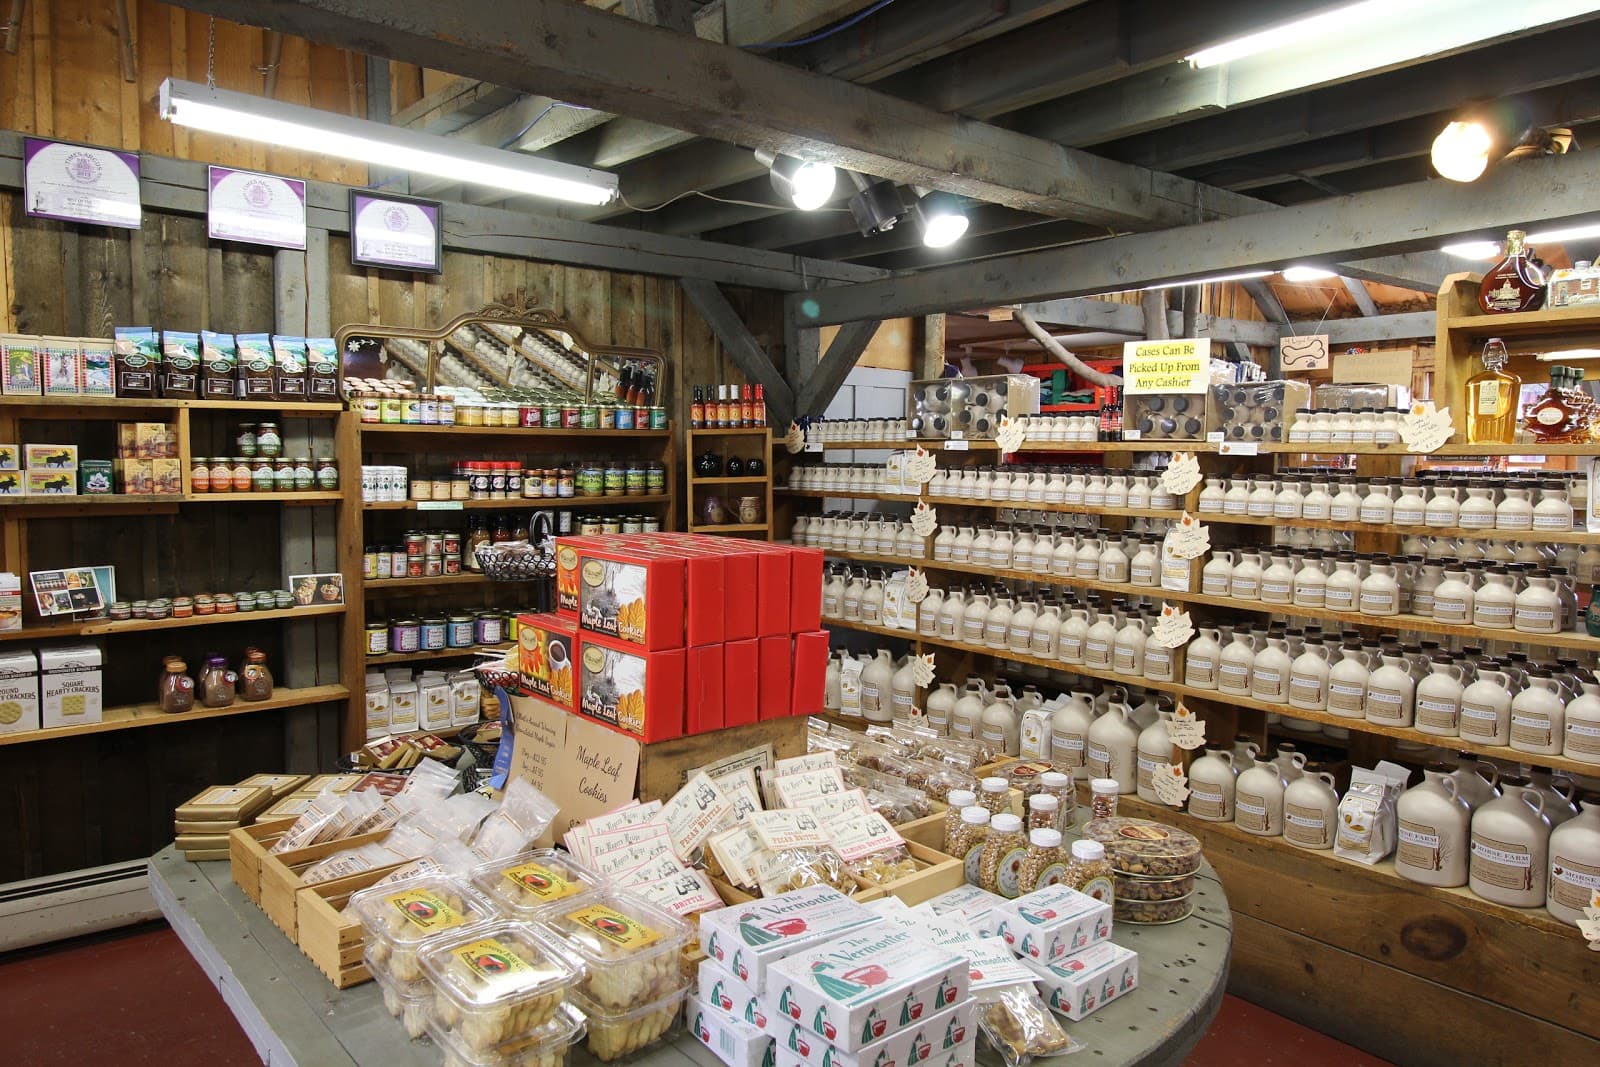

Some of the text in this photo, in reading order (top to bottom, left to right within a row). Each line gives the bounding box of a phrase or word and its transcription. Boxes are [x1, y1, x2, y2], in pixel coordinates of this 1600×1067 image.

[1136, 345, 1195, 357] Cases Can Be
[1129, 362, 1200, 374] Picked Up From
[1136, 377, 1192, 389] Any Cashier
[560, 594, 578, 608] Maple
[581, 612, 644, 637] Maple Leaf Cookies
[62, 680, 84, 688] SQUARE
[521, 672, 570, 699] Maple Leaf Cookies
[46, 688, 70, 698] HEARTY
[582, 698, 641, 728] Maple Leaf Cookies
[576, 745, 622, 782] Maple Leaf
[578, 777, 607, 803] Cookies
[679, 828, 700, 848] PECAN
[698, 805, 721, 830] BRITTLE
[1504, 852, 1529, 862] FARM
[1565, 872, 1597, 883] MORSE
[674, 895, 704, 910] BRITTLE
[760, 892, 842, 914] Vermonter
[772, 895, 802, 904] The
[930, 927, 949, 938] The
[829, 931, 912, 961] Vermonter
[840, 936, 870, 947] The
[969, 949, 986, 958] The
[970, 957, 1012, 968] ermonter
